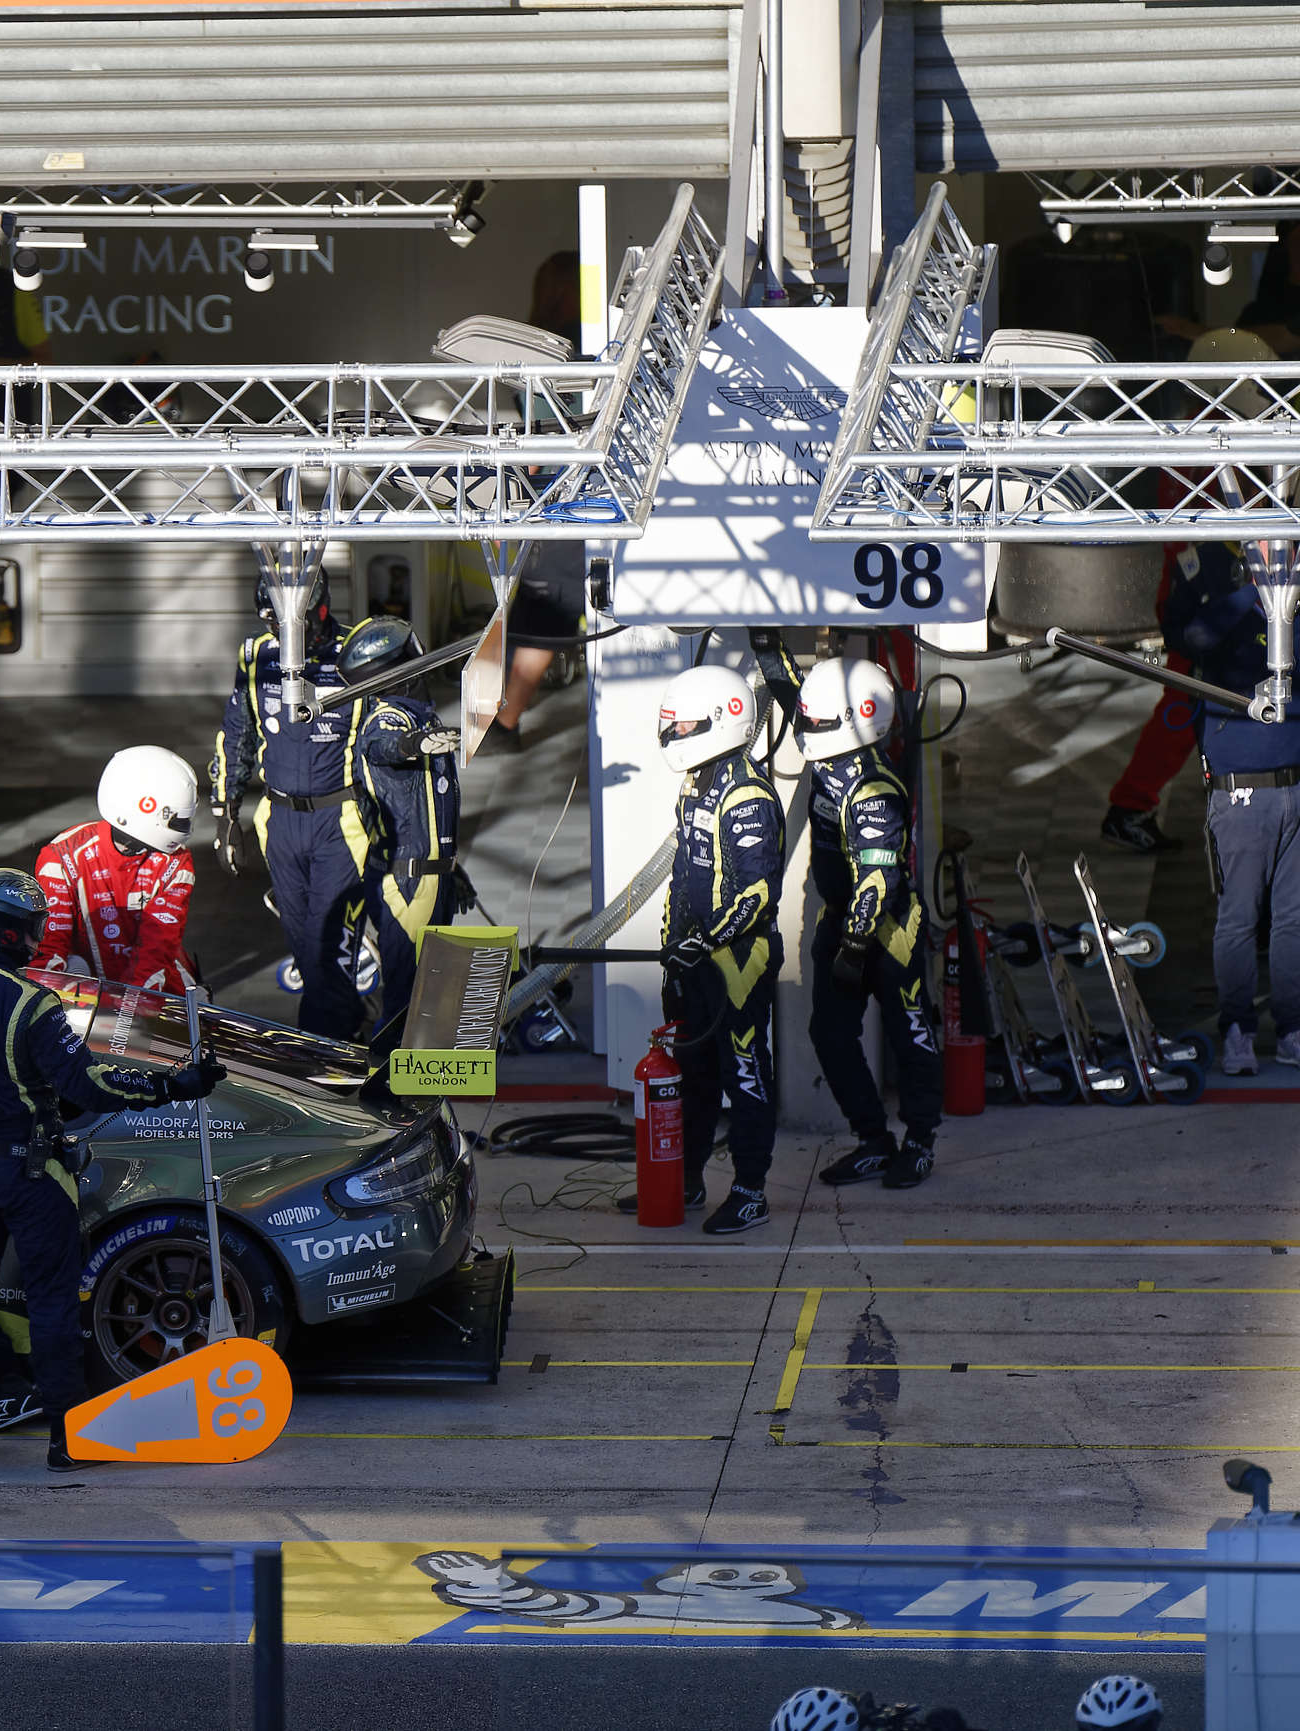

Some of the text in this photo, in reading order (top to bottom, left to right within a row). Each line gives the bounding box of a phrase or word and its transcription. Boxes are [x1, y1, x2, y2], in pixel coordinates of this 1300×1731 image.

[132, 236, 335, 275] MARIN
[41, 294, 234, 334] RACING
[704, 441, 780, 458] ASTON
[854, 543, 943, 609] 98
[394, 1058, 493, 1075] HACKETT
[419, 1077, 467, 1086] LONDON
[124, 1115, 246, 1131] WALDORF ATORIA
[135, 1129, 234, 1140] HOTELS & REORTS
[273, 1206, 316, 1226] DUPONT
[90, 1219, 168, 1271] MICHELIN
[292, 1230, 395, 1262] TOTAL
[347, 1290, 389, 1305] MICHELIN
[207, 1360, 266, 1438] 98
